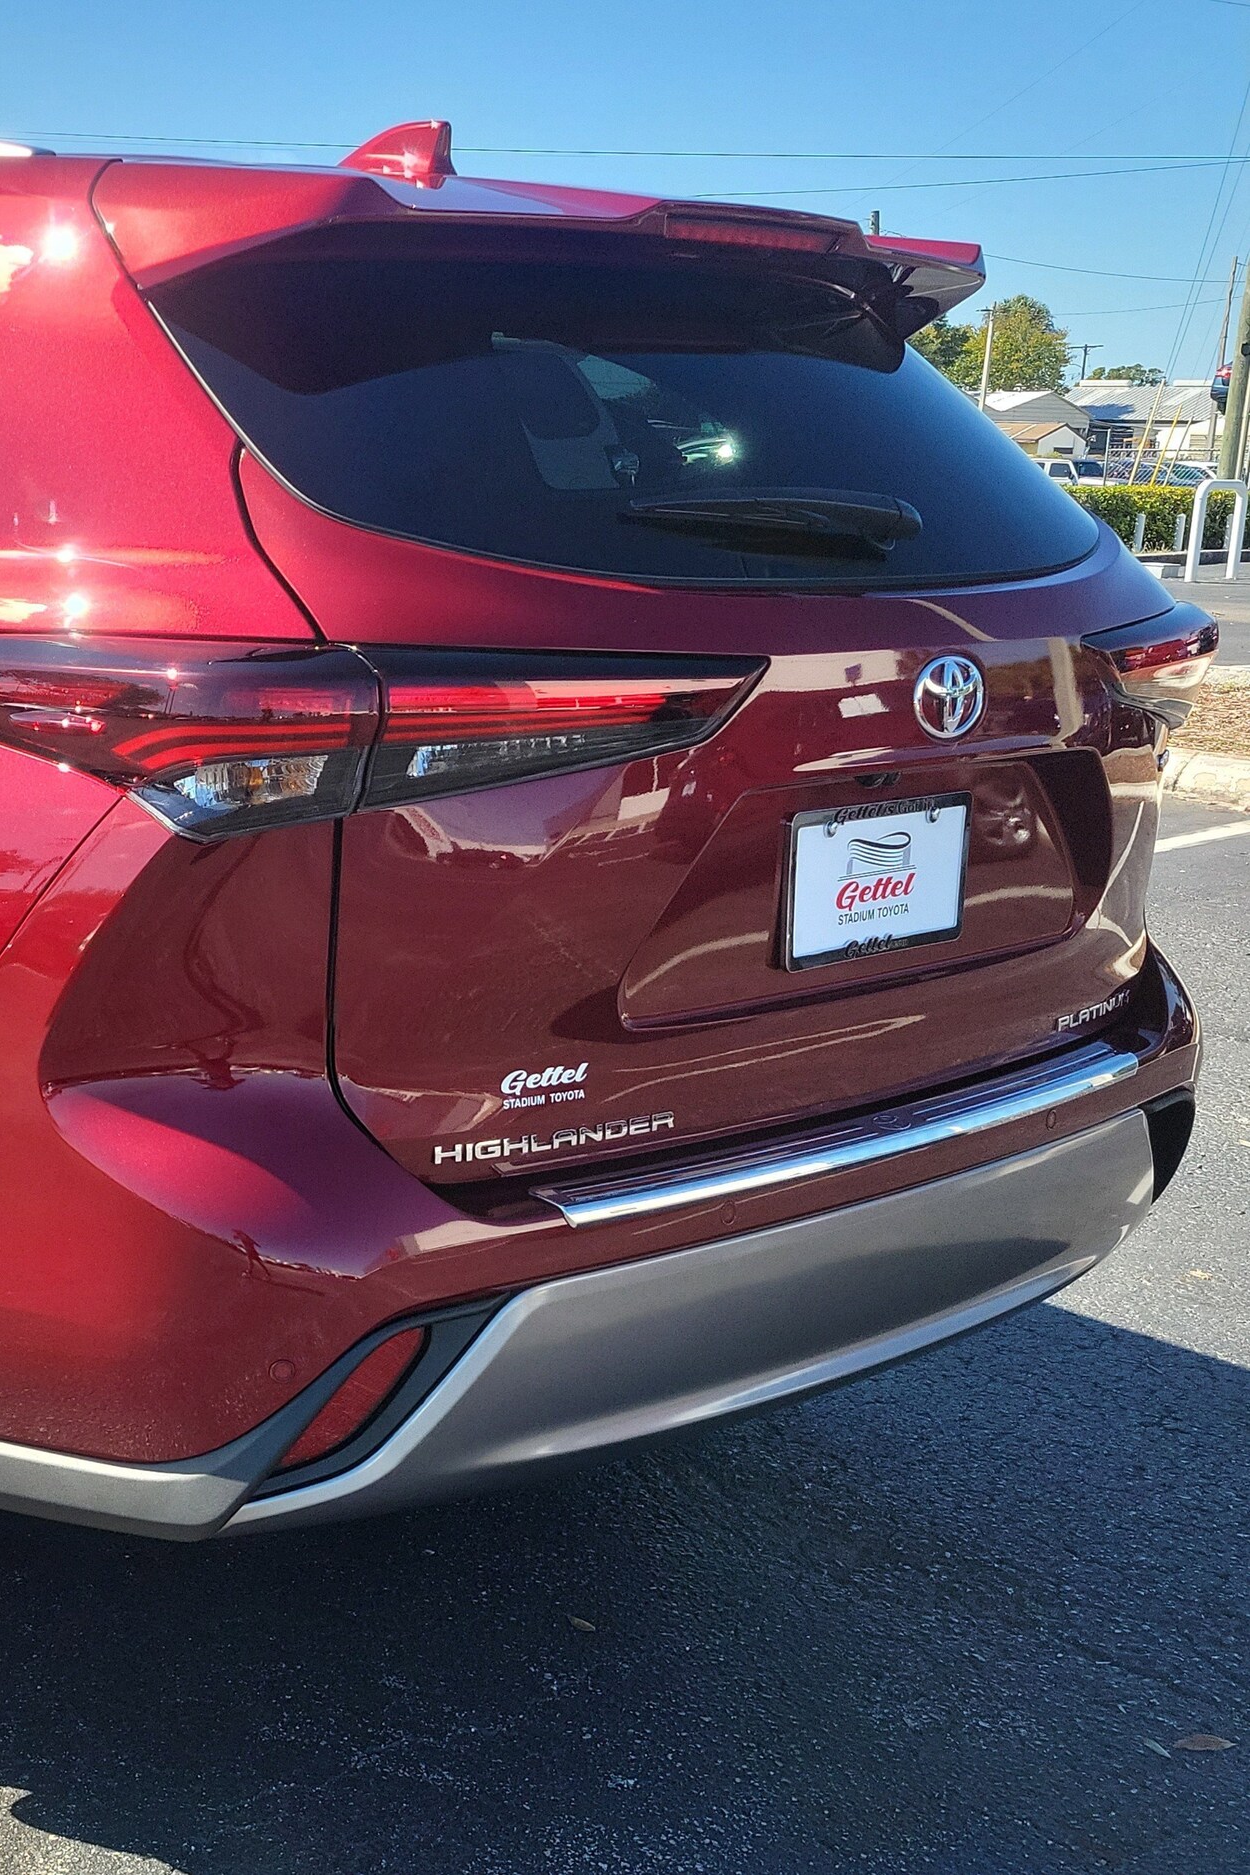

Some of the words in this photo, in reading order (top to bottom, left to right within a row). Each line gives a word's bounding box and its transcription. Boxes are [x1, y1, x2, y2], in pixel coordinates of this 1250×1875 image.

[835, 872, 916, 911] Gettel
[837, 909, 875, 926] STADIUM
[877, 903, 910, 919] TOYOTA
[844, 933, 893, 959] Gettel
[500, 1062, 589, 1096] Gettel
[502, 1094, 546, 1110] STADIUM
[549, 1089, 586, 1104] TOYOTA
[434, 1111, 675, 1165] HIGHLANDER
